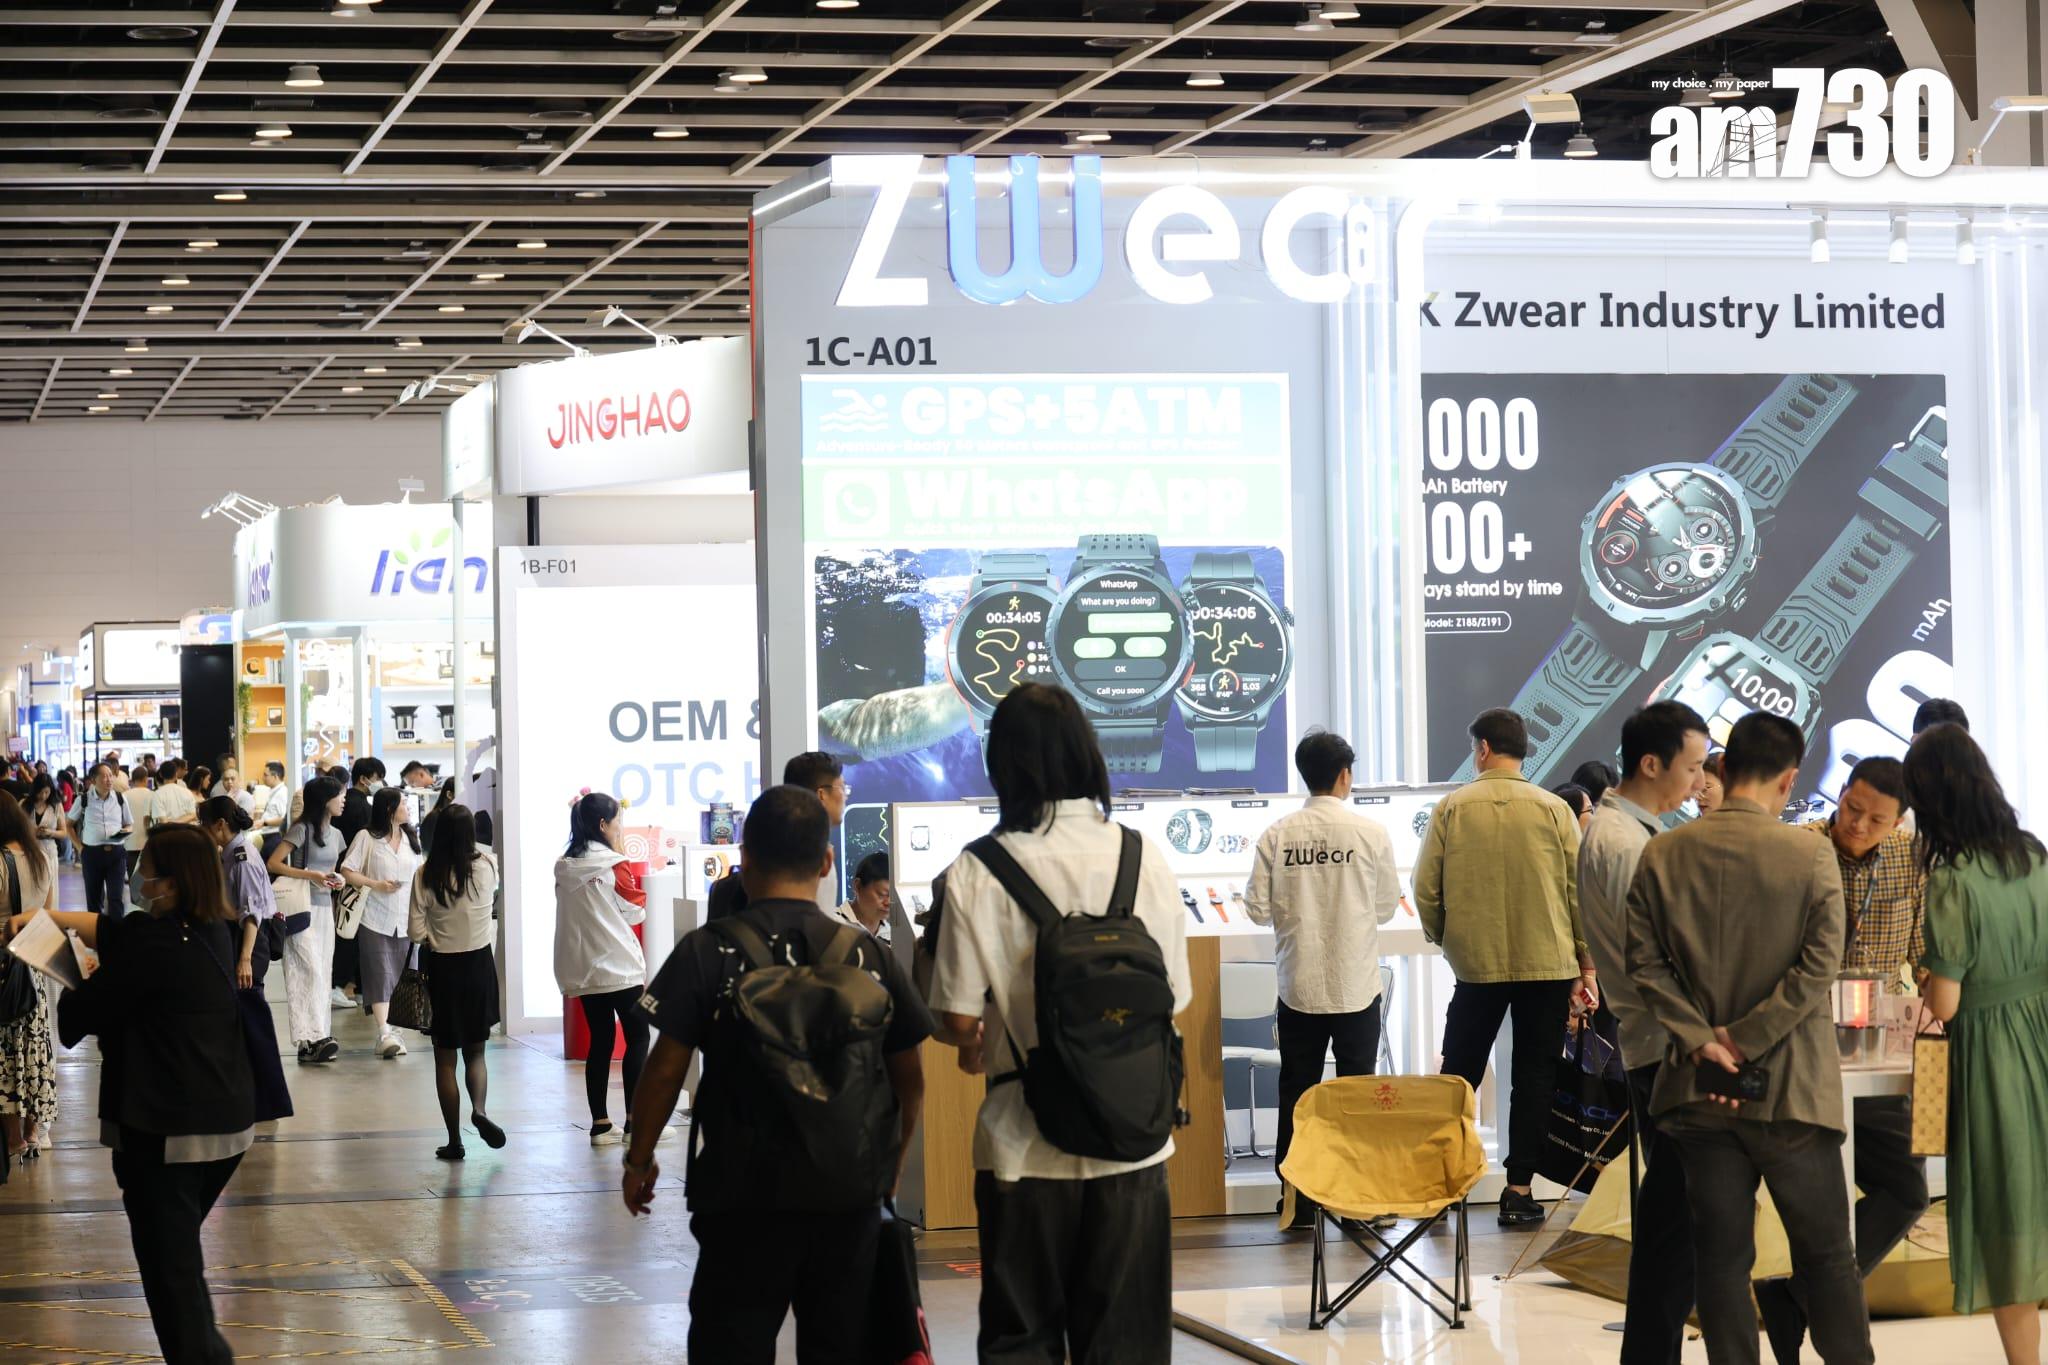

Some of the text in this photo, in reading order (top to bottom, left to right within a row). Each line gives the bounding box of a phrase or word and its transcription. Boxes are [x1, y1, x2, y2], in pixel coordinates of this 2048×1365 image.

[1454, 291, 1587, 328] Zwear
[1599, 290, 1780, 339] Industry
[1793, 292, 1945, 329] Limited
[806, 336, 937, 367] 1C-A01
[549, 388, 690, 449] JINGHAO
[901, 385, 1242, 435] GPS+5ATM
[1422, 397, 1539, 471] 000
[904, 469, 1247, 532] WhatsApp
[1451, 477, 1508, 497] Battery
[1424, 500, 1532, 575] 00+
[521, 559, 576, 575] 1B-F01
[1100, 580, 1138, 590] WhatsApp
[1455, 580, 1500, 597] stand
[1503, 579, 1524, 599] by
[1527, 579, 1563, 596] time
[986, 612, 1041, 623] 00:34:05
[1081, 597, 1101, 606] What
[1115, 599, 1130, 607] you
[1131, 597, 1157, 607] doing?
[1911, 597, 1951, 642] mAh
[1114, 665, 1127, 673] OK
[1729, 666, 1795, 716] 10:09
[1096, 687, 1110, 695] Call
[1111, 689, 1126, 697] you
[609, 699, 727, 743] OEM
[612, 761, 725, 808] OTC
